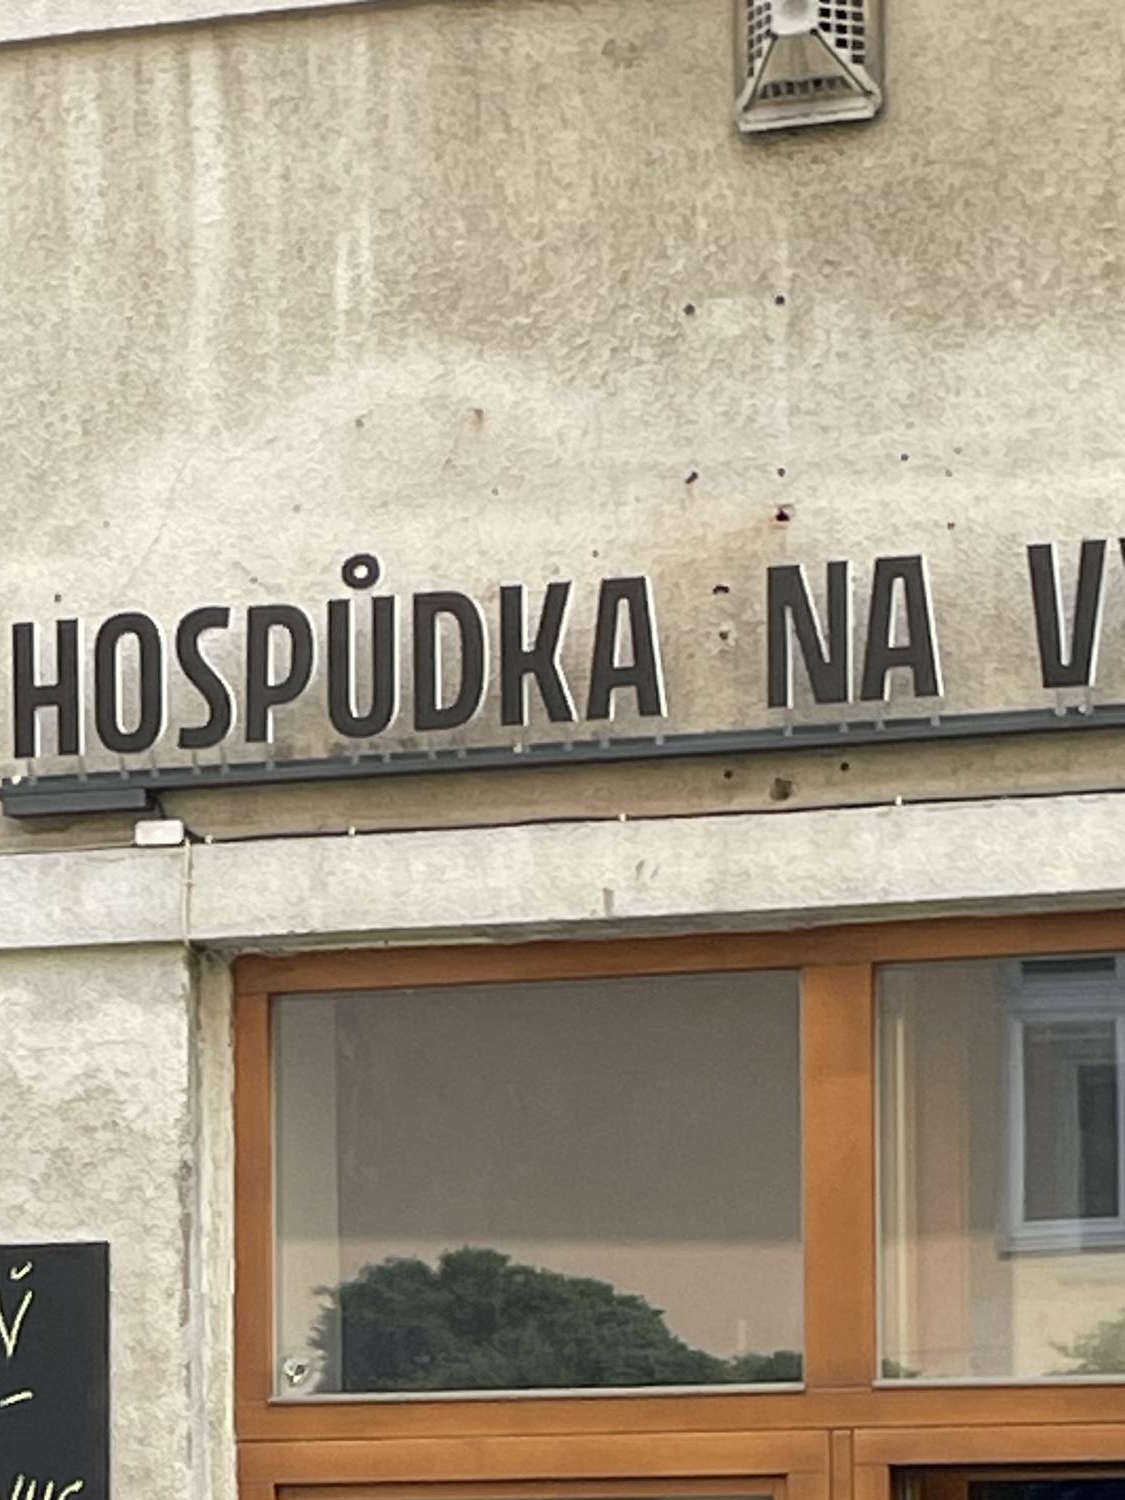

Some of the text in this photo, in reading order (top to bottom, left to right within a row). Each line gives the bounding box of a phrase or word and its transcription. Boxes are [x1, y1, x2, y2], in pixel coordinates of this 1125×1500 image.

[12, 537, 1125, 759] HOSPŮDKA NA V
